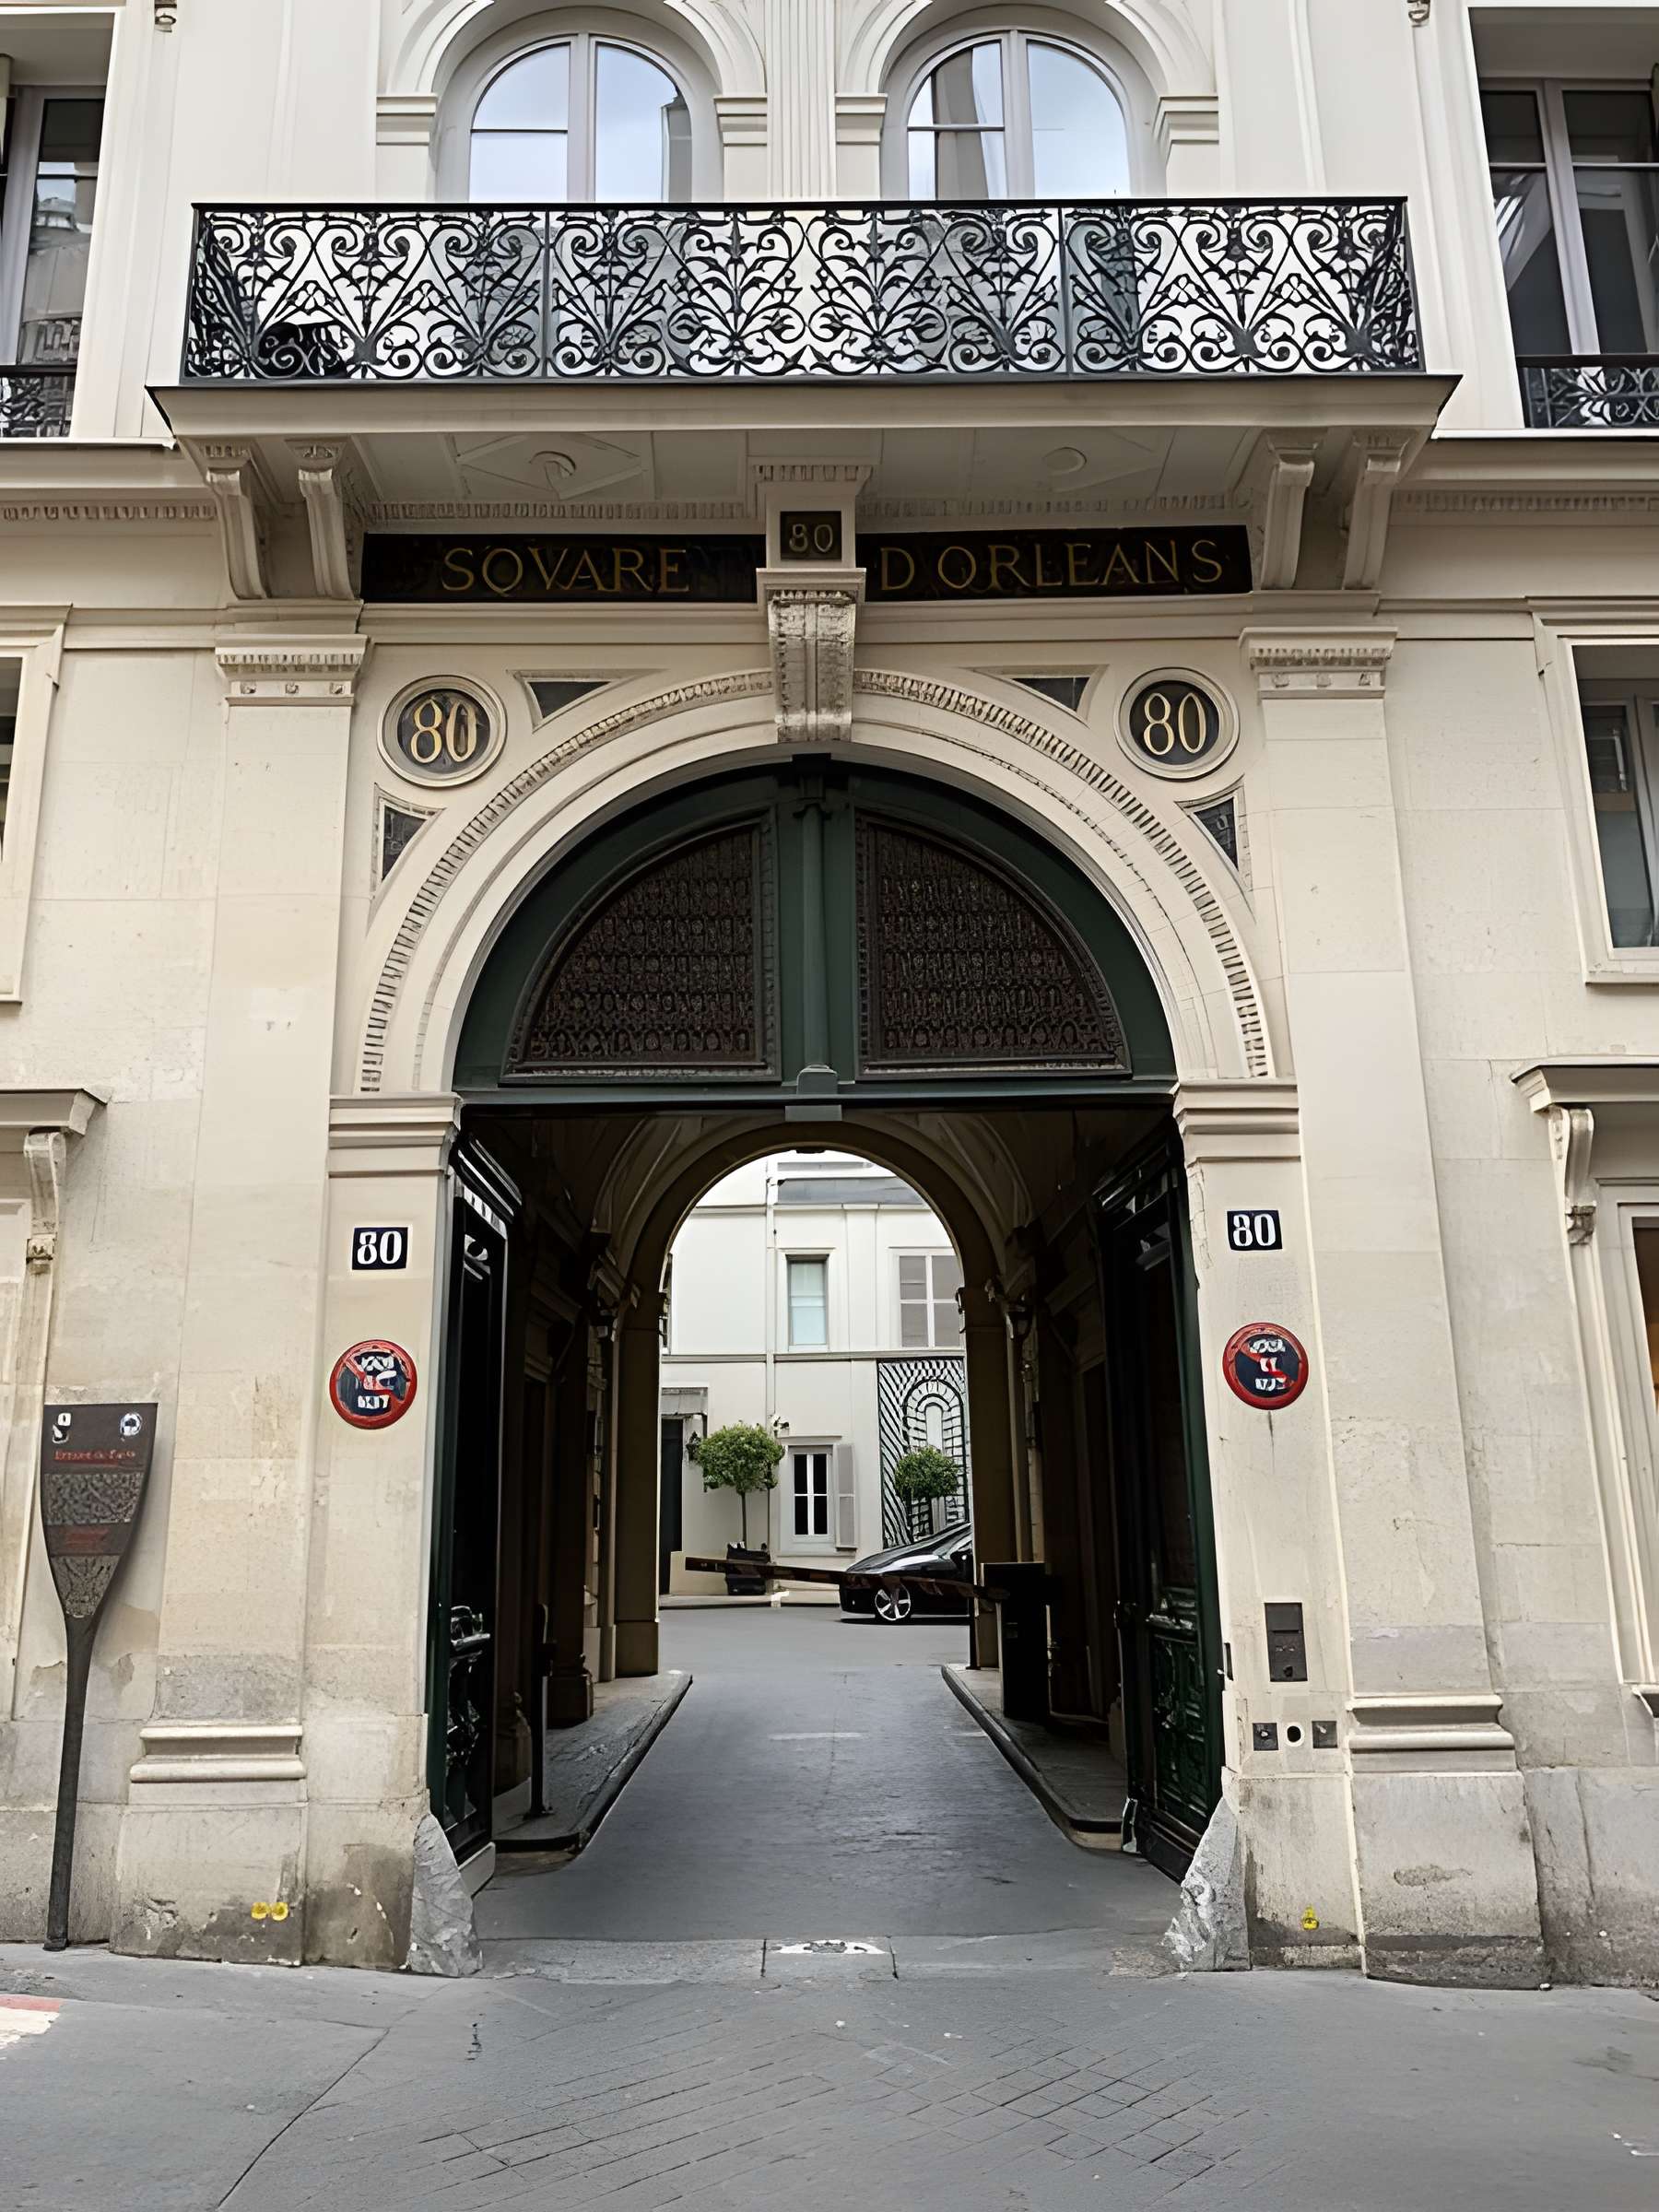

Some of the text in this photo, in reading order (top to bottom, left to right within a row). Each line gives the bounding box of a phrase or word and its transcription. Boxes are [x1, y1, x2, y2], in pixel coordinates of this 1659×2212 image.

[789, 524, 833, 553] 80
[411, 699, 477, 763] 80
[1143, 692, 1206, 755] 80
[1233, 1214, 1277, 1246] 80
[357, 1231, 402, 1265] 80
